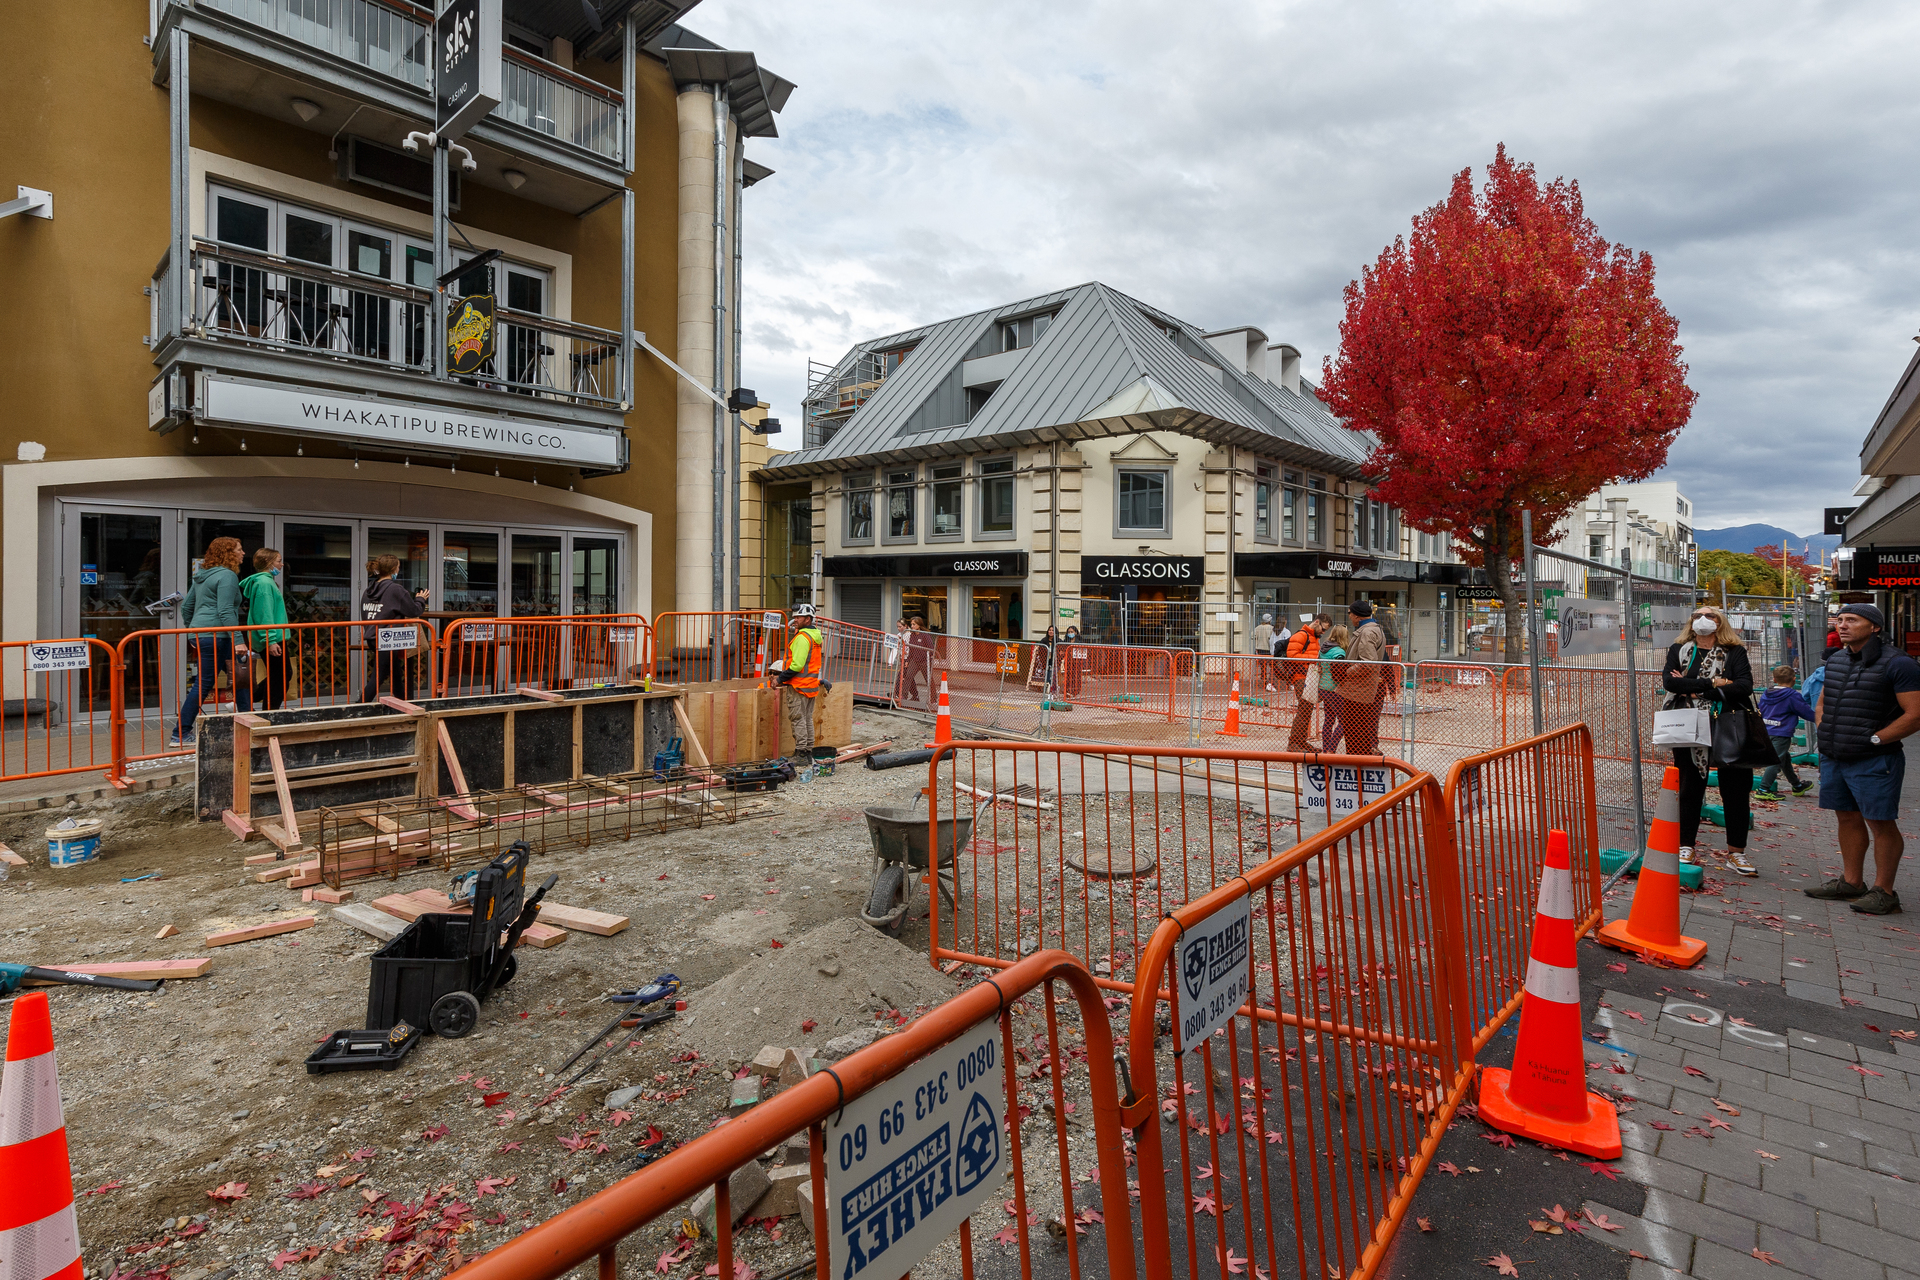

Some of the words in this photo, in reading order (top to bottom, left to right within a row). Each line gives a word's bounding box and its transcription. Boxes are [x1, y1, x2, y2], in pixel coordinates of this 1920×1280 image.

[447, 82, 468, 107] CASINO
[301, 402, 437, 433] WHAKATIPU
[443, 421, 534, 445] BREWING
[538, 434, 567, 450] CO.
[953, 560, 1000, 572] GLASSONS
[1096, 562, 1191, 578] GLASSONS
[1327, 560, 1353, 572] GLASSONS
[52, 646, 86, 654] FAHEY
[1334, 769, 1385, 782] FAHEY
[1337, 782, 1360, 791] FENC
[1363, 784, 1384, 792] HIRE
[1335, 798, 1353, 810] 343
[1209, 914, 1247, 963] FAHEY
[1210, 957, 1232, 981] FENCE
[1232, 943, 1247, 966] HIRE
[1184, 1006, 1206, 1042] 0800
[1210, 992, 1225, 1022] 343
[1228, 982, 1237, 1007] 99
[1239, 973, 1247, 997] 60
[957, 1039, 995, 1091] 0800
[1539, 1063, 1570, 1076] Huanui
[915, 1070, 949, 1121] 343
[879, 1100, 905, 1145] 99
[839, 1123, 868, 1172] 60
[896, 1131, 948, 1187] FENCE
[843, 1157, 953, 1280] FAHEY
[846, 1172, 893, 1225] HIRE
